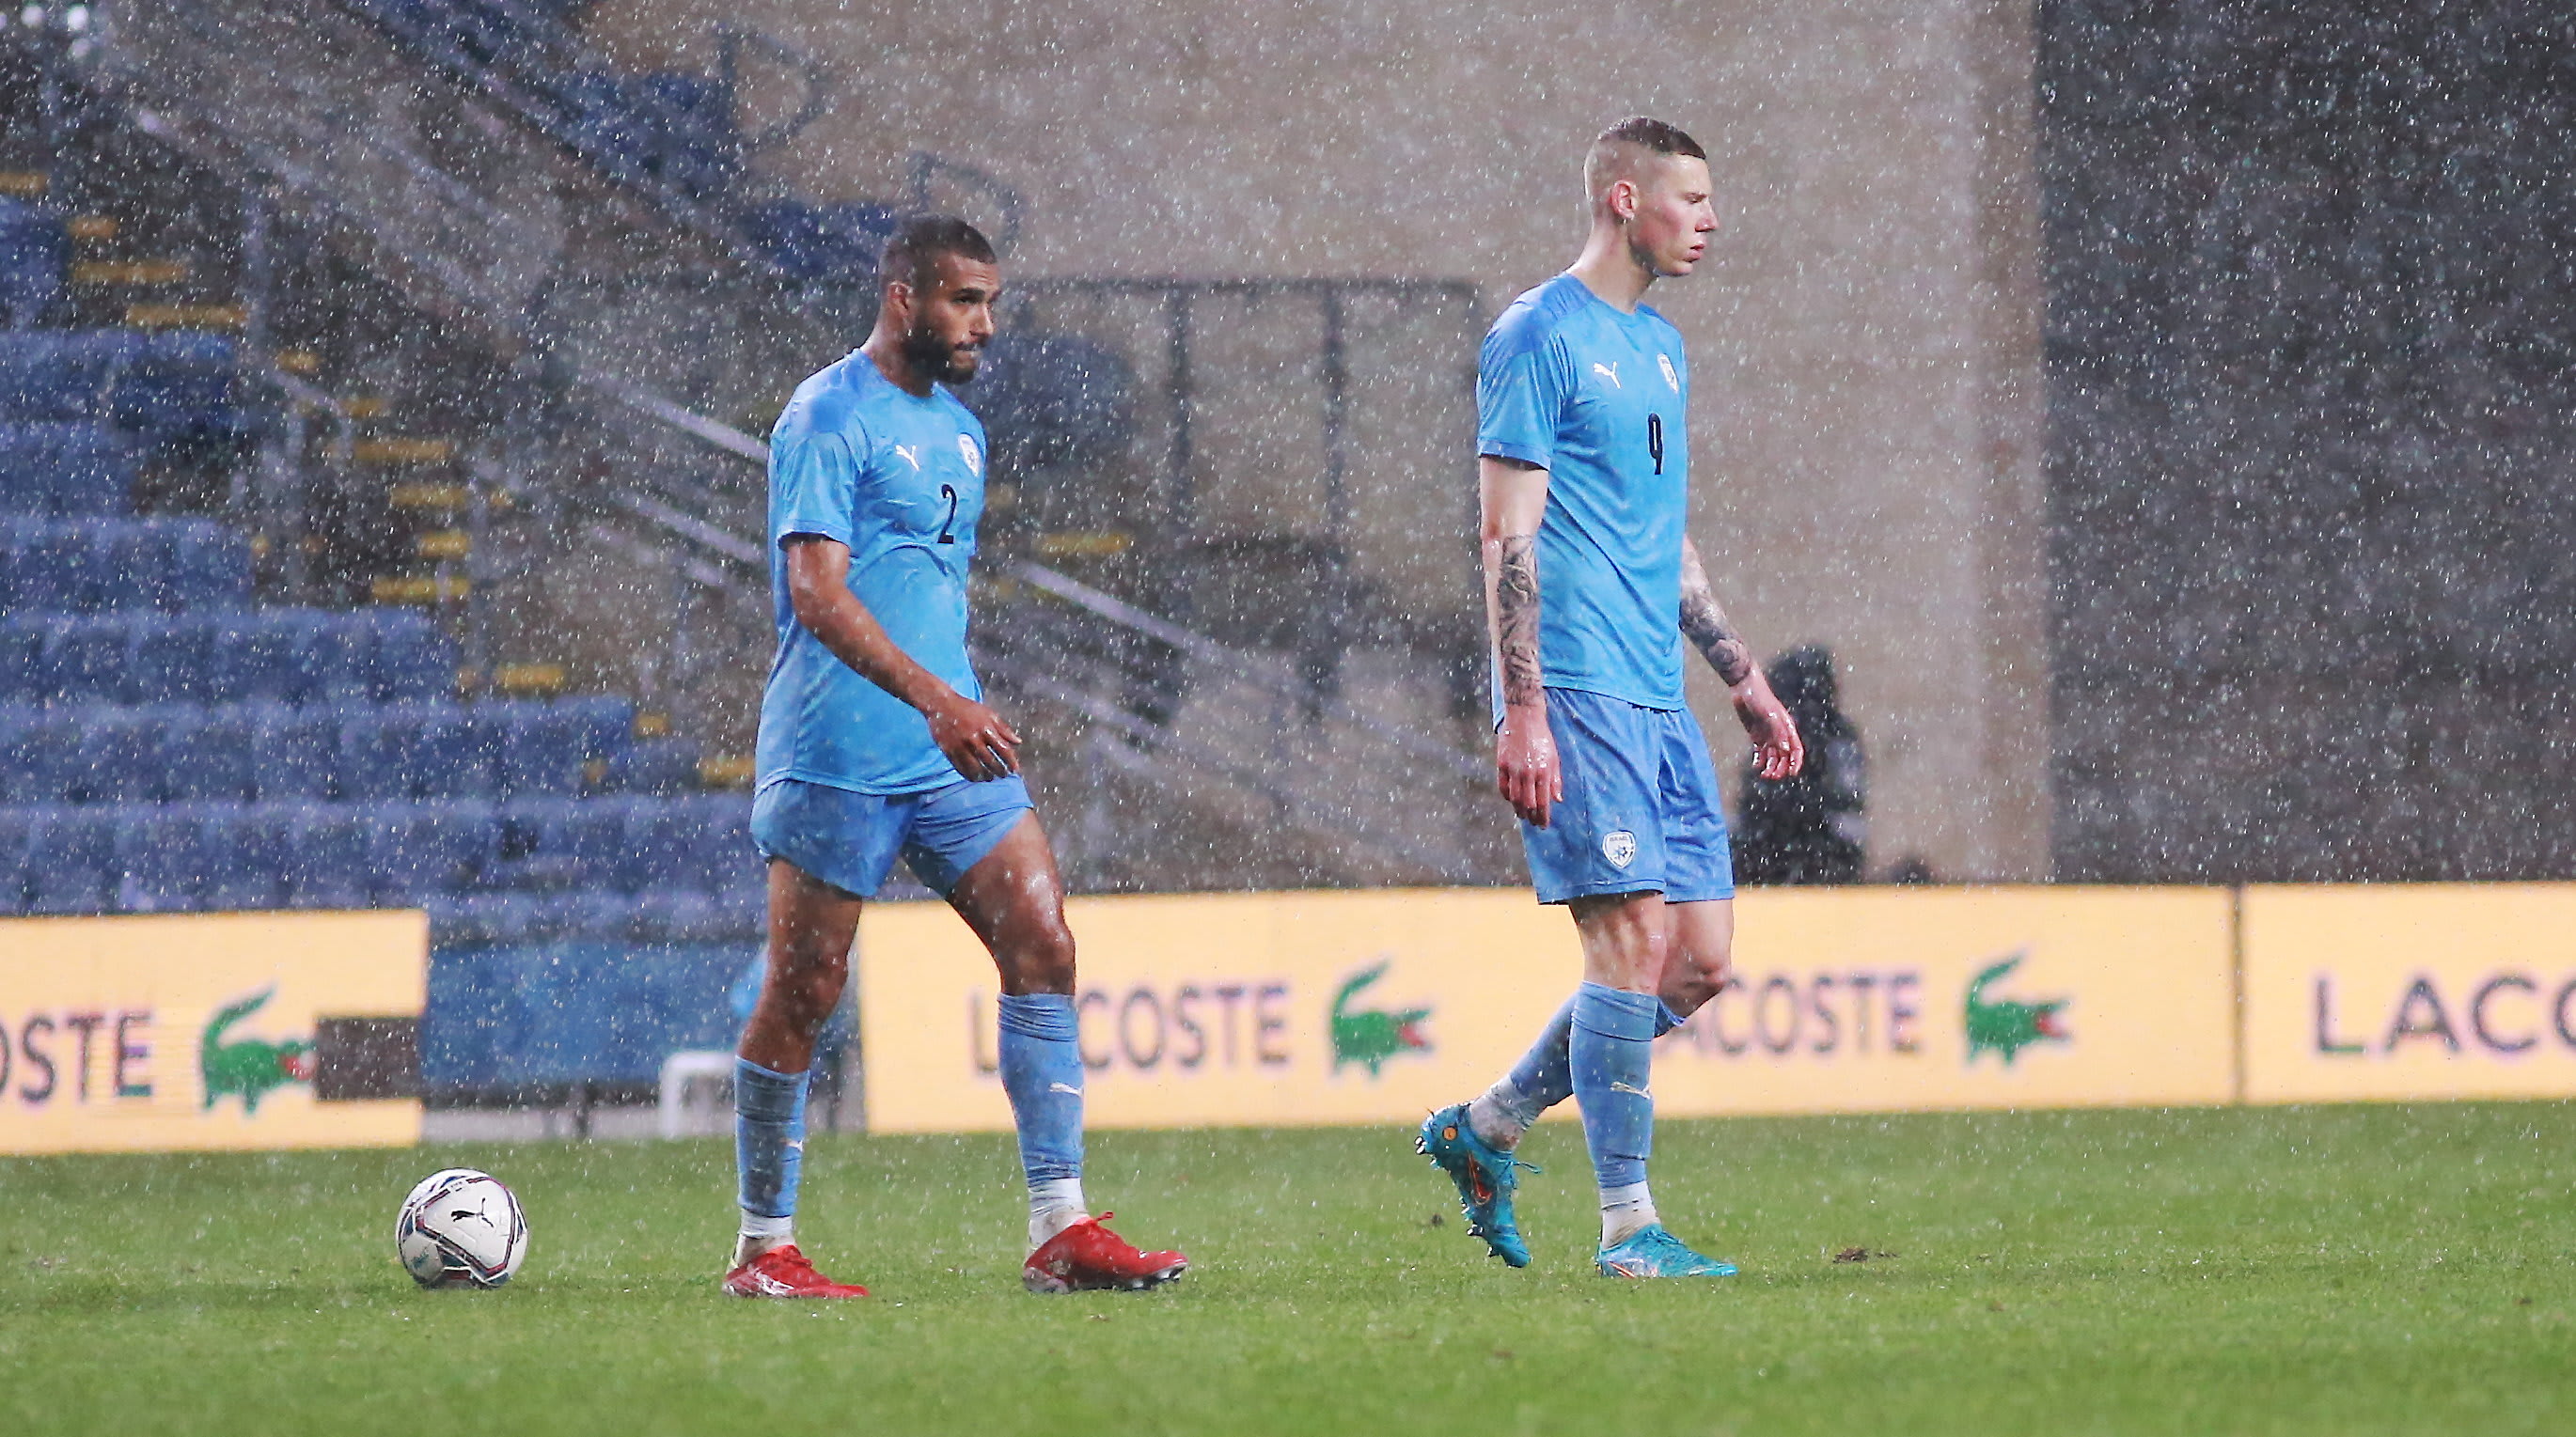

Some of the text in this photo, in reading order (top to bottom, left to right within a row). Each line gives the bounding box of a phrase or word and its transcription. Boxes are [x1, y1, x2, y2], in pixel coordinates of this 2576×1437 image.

[1648, 412, 1663, 476] 9
[937, 483, 957, 544] 2
[971, 985, 1290, 1071] LCOSTE
[2316, 976, 2576, 1054] LAC
[0, 1013, 152, 1103] STE
